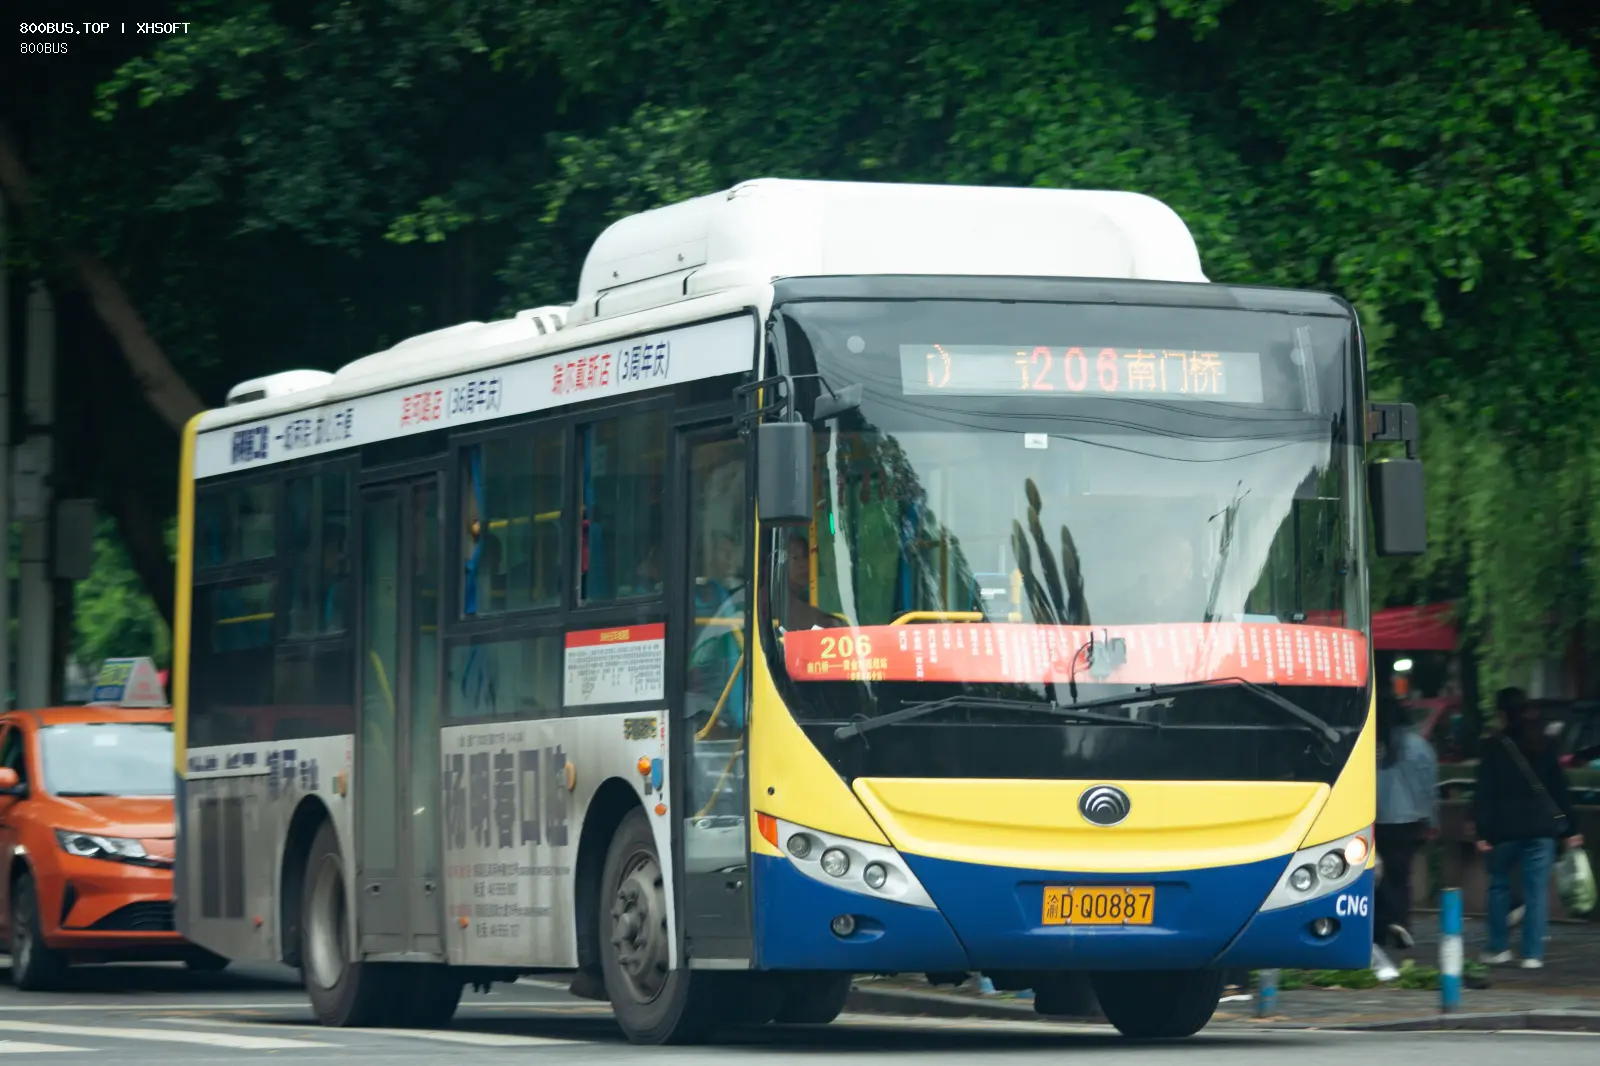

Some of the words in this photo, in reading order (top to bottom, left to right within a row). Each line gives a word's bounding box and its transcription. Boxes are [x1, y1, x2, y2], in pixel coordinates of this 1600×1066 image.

[1030, 346, 1119, 392] 206
[1124, 348, 1223, 394] 南门桥
[820, 633, 872, 659] 206
[1335, 894, 1369, 918] CNG
